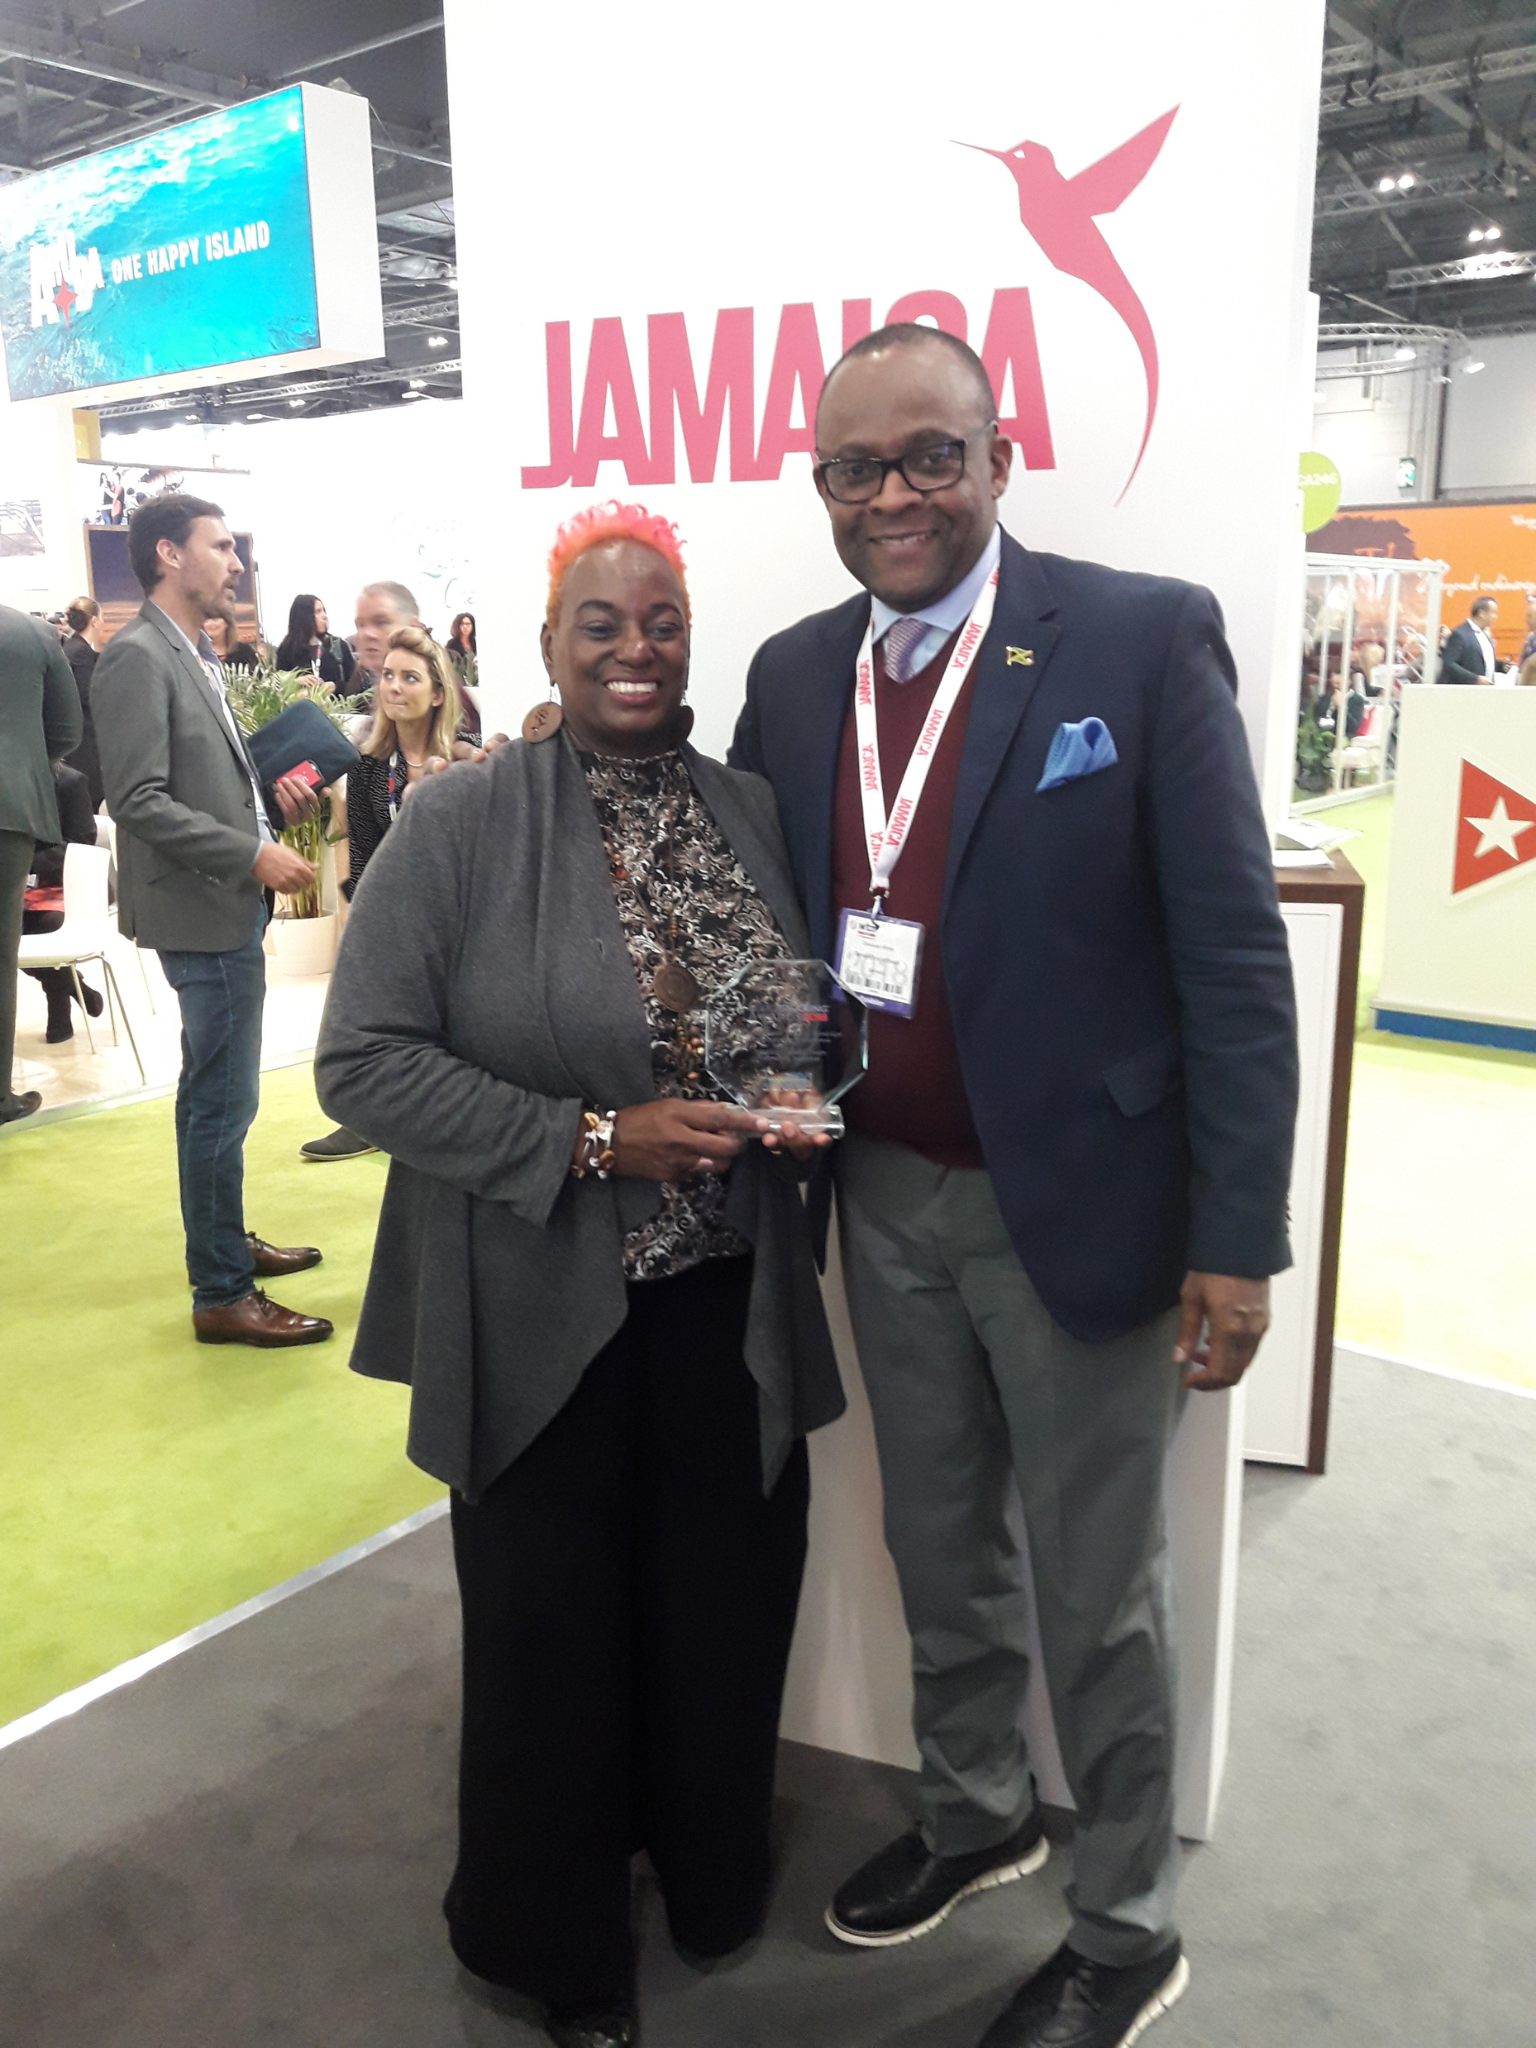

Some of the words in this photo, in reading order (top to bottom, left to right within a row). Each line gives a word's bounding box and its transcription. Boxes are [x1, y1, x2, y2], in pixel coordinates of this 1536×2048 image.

[111, 253, 143, 284] ONE
[146, 237, 200, 276] HAPPY
[204, 219, 270, 262] ISLAND
[521, 286, 1056, 488] JAMAA
[951, 620, 983, 670] JAMAICA
[915, 708, 944, 759] JAMAICA
[861, 744, 878, 791] JAMAICA
[885, 797, 913, 847] JAMAICA
